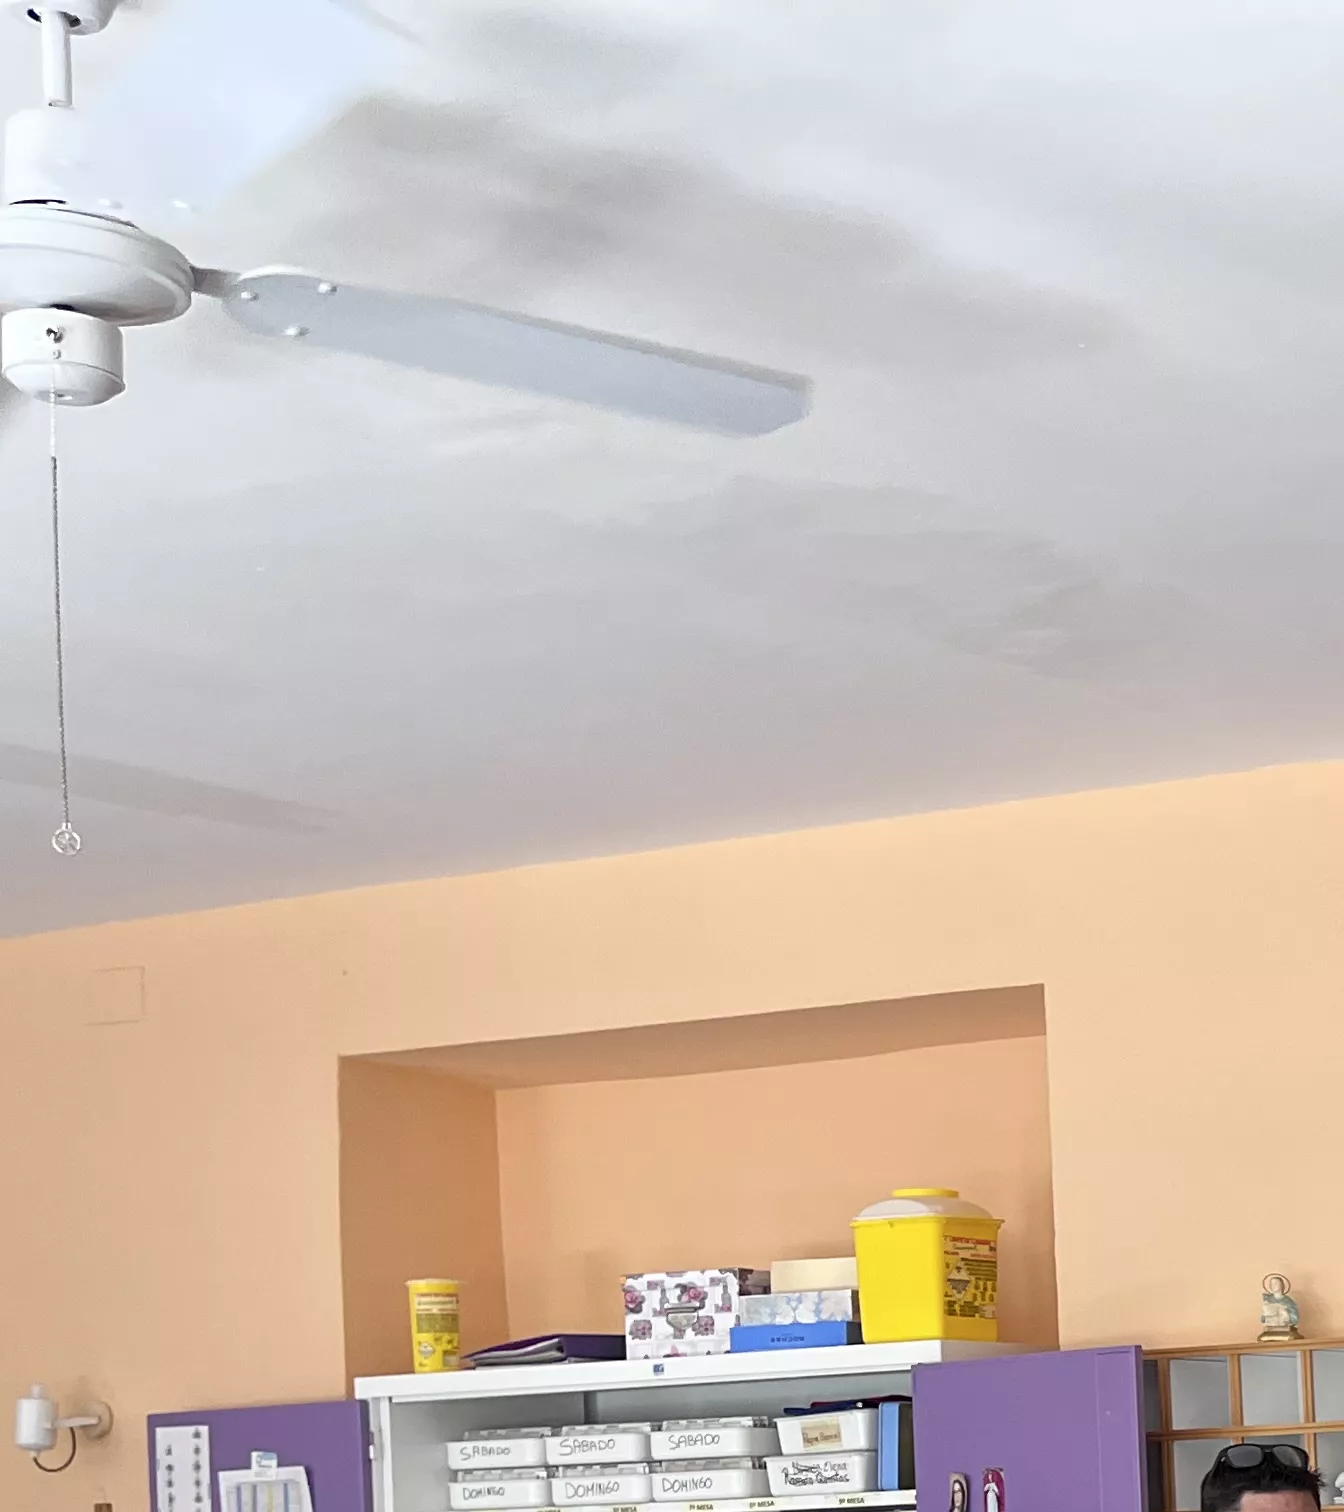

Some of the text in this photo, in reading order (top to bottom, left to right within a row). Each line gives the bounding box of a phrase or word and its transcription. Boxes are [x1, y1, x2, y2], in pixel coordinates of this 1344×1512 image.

[559, 1438, 616, 1456] SABADO
[668, 1433, 720, 1450] SABADO
[460, 1445, 511, 1461] SABADO
[462, 1486, 506, 1500] DOMINGO
[564, 1480, 620, 1499] DOMINGO
[661, 1477, 713, 1493] DOMINGO
